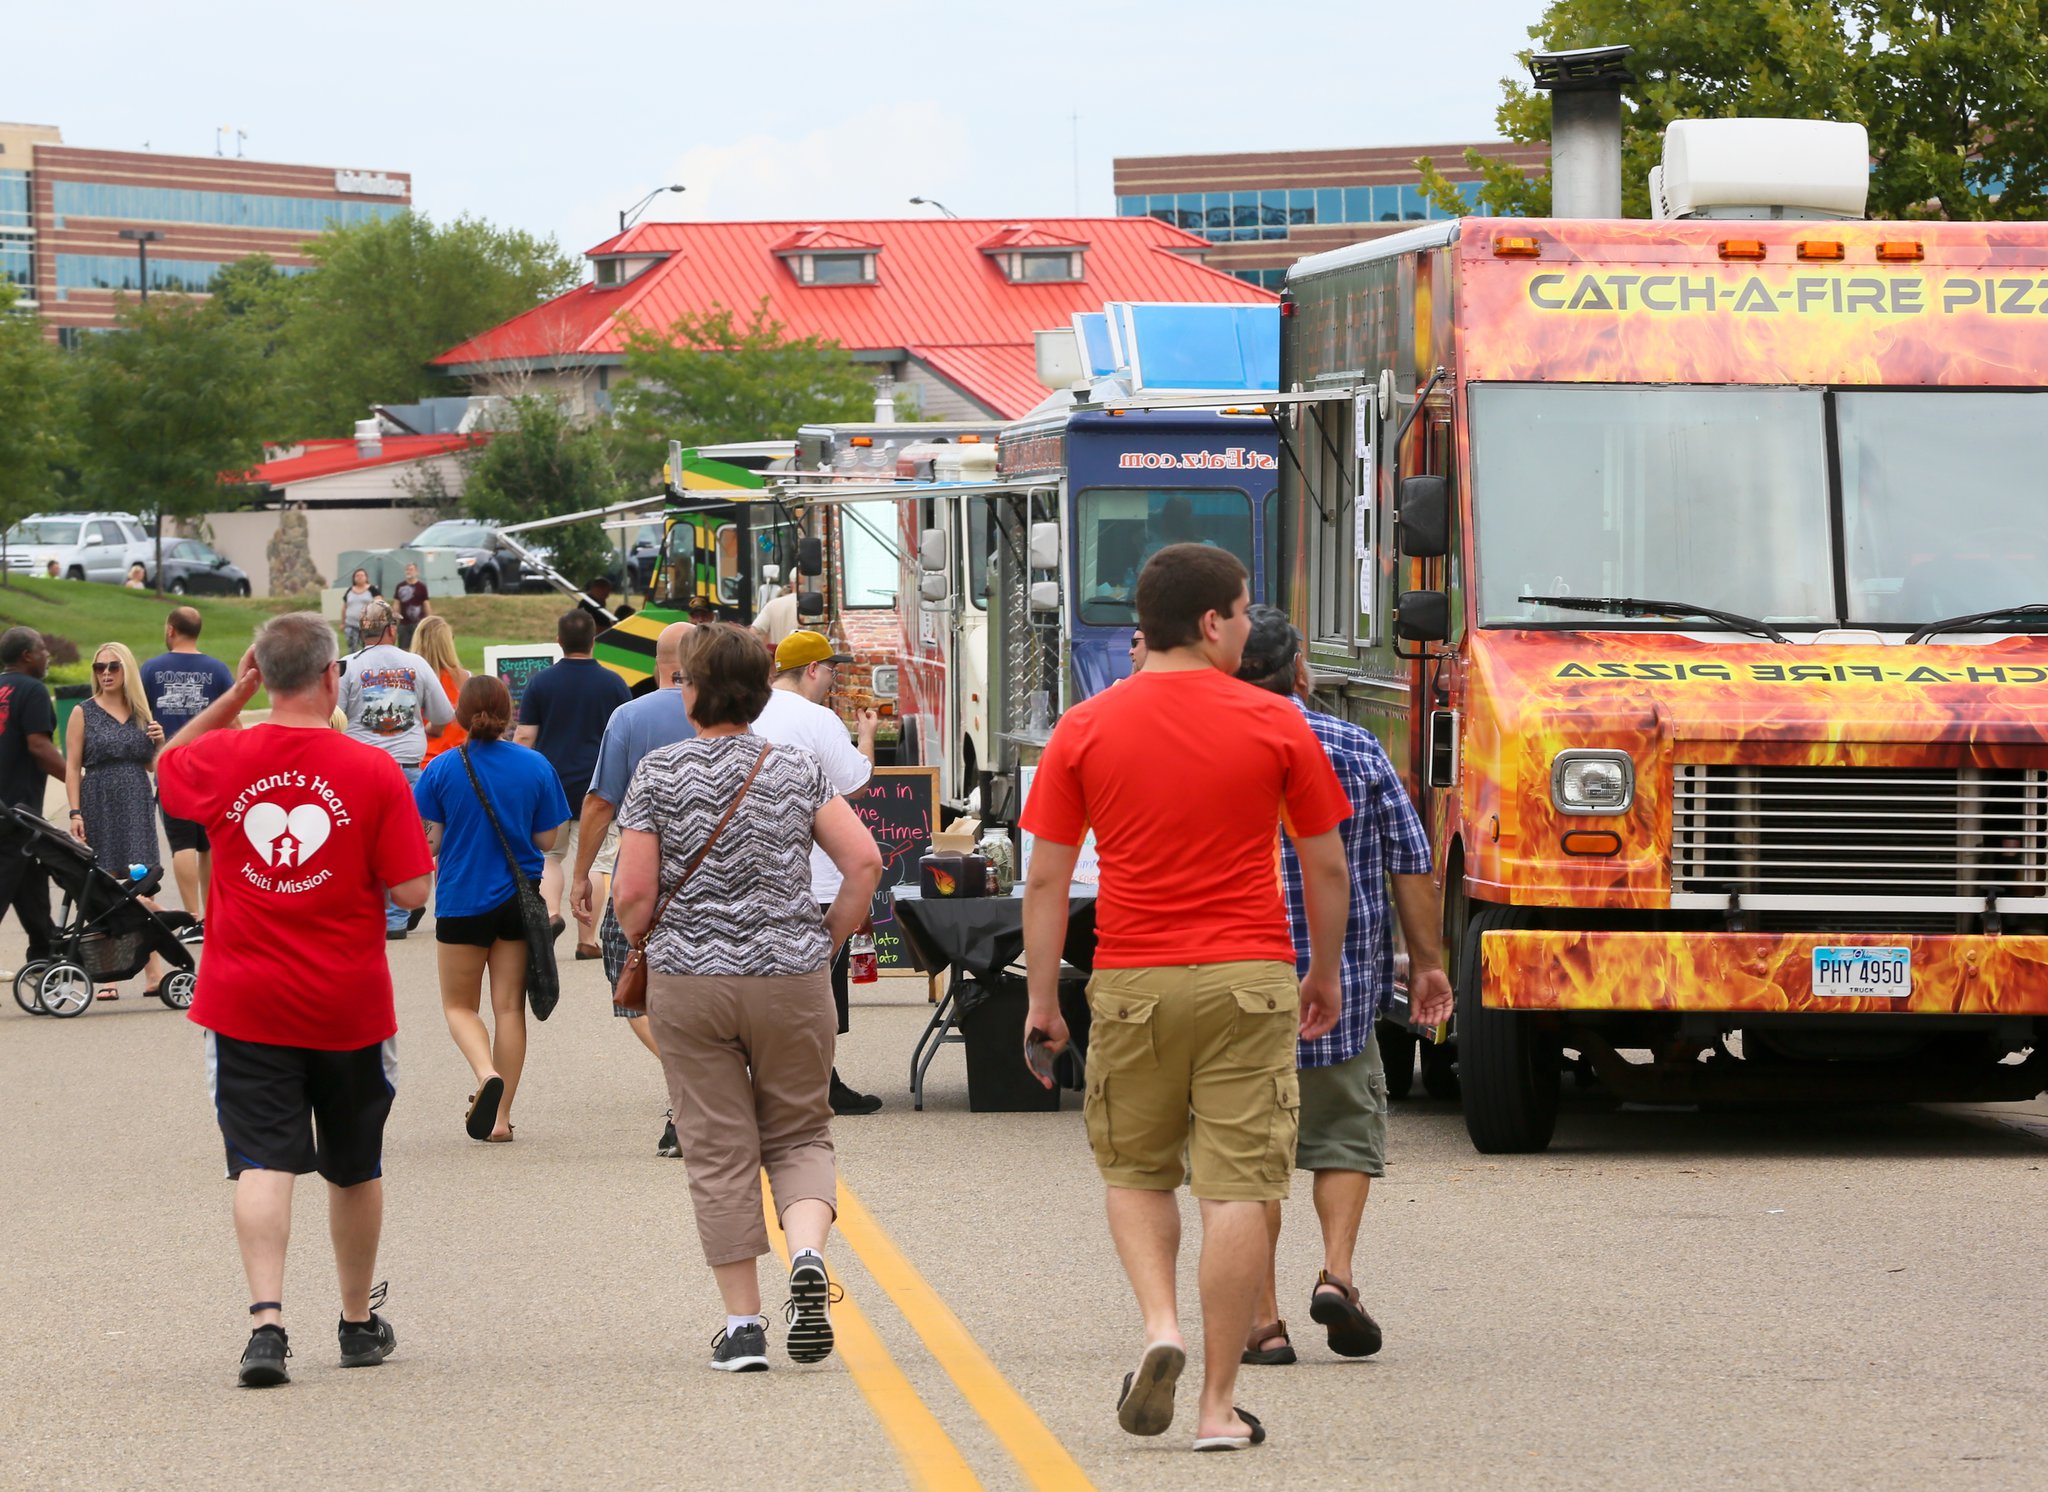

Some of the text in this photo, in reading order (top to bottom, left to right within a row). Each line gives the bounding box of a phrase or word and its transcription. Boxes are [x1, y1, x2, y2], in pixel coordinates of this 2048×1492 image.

[1529, 274, 1925, 314] CATCH-A-FIRE
[154, 670, 213, 685] BOSTON
[225, 770, 351, 827] Servant's Heart
[866, 783, 912, 799] un in
[241, 862, 333, 893] Haiti Mission
[1820, 960, 1903, 983] PHY 4950
